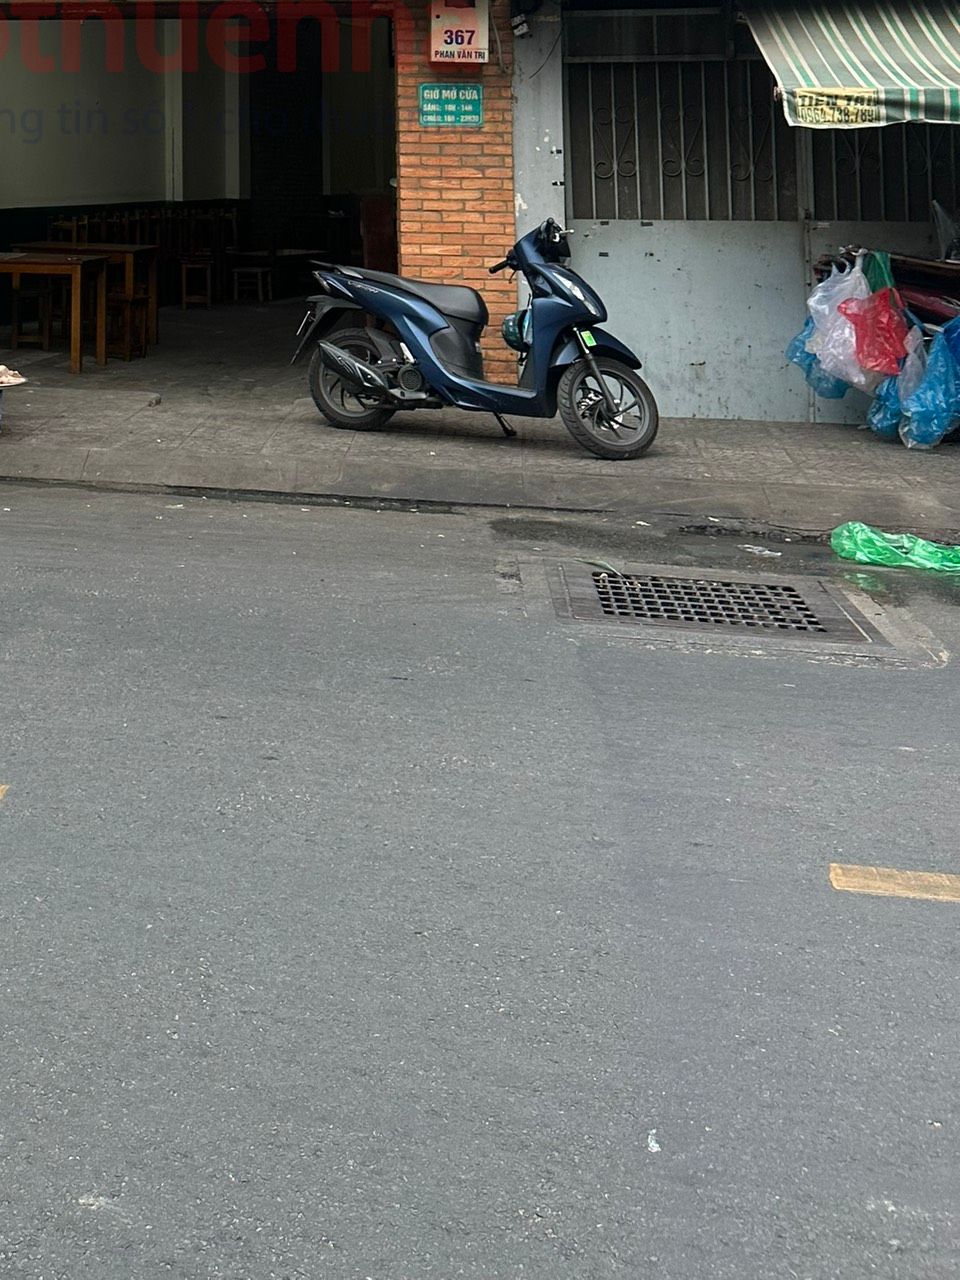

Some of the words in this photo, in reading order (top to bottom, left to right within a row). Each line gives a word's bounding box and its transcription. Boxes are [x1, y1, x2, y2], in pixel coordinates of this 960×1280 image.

[444, 30, 476, 46] 367
[434, 50, 456, 59] PHAN
[473, 50, 486, 61] TRỊ
[460, 86, 478, 100] CỬA
